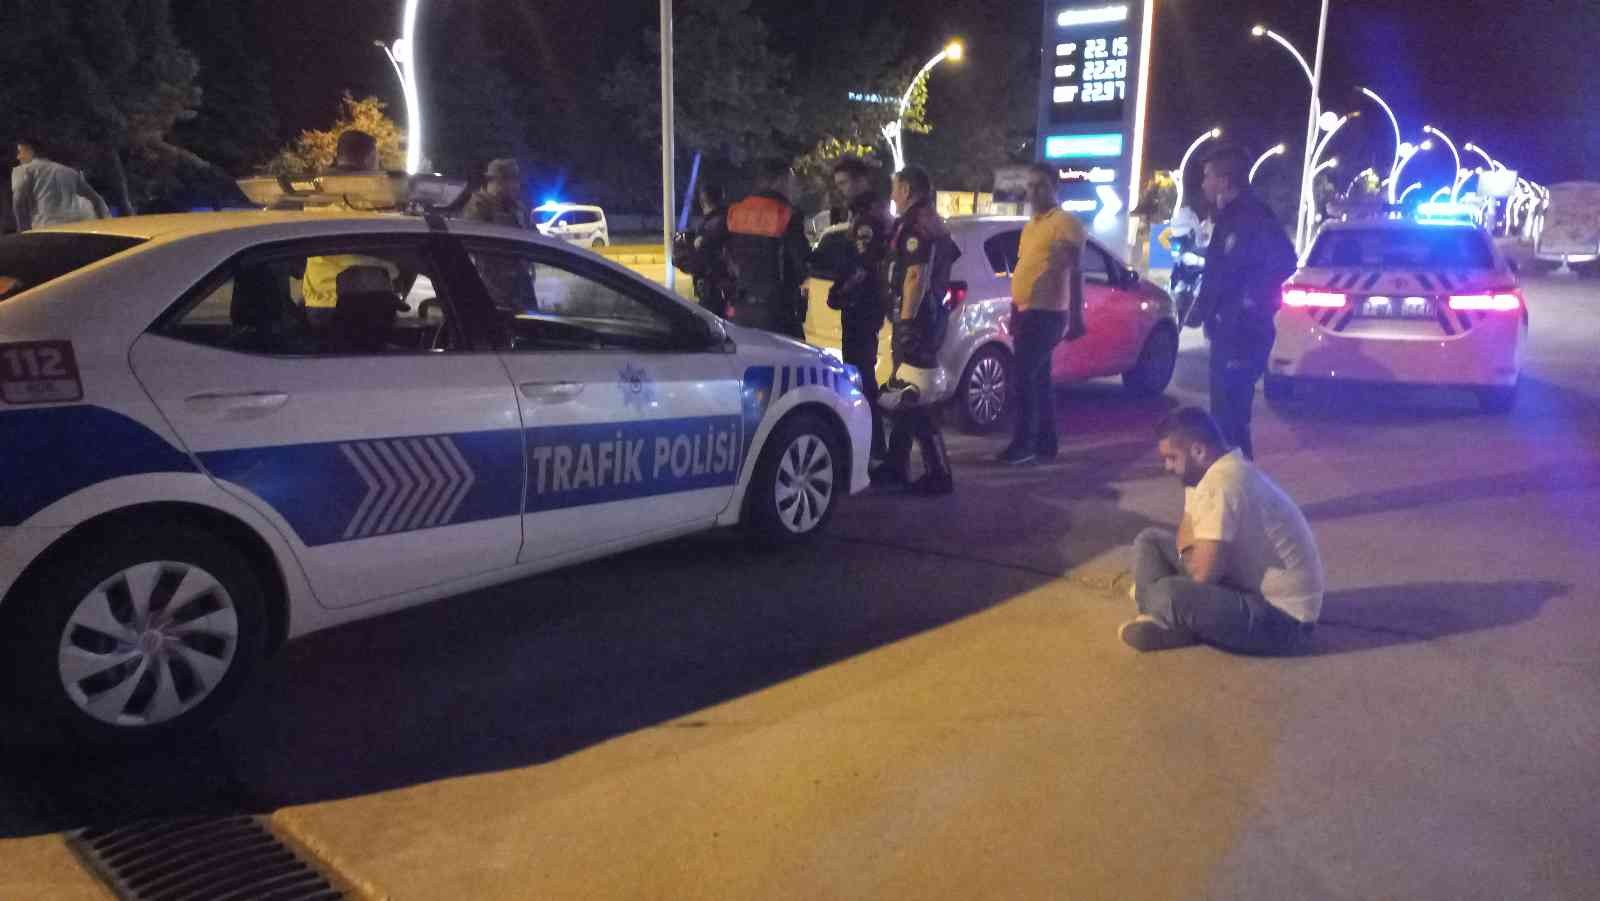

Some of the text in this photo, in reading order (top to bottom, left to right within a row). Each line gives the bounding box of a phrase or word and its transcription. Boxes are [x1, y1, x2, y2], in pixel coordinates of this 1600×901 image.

[1084, 37, 1128, 58] 22.15
[1083, 59, 1127, 80] 22.20
[3, 347, 67, 378] 112
[533, 423, 737, 495] TRAFİK POLİSİ
